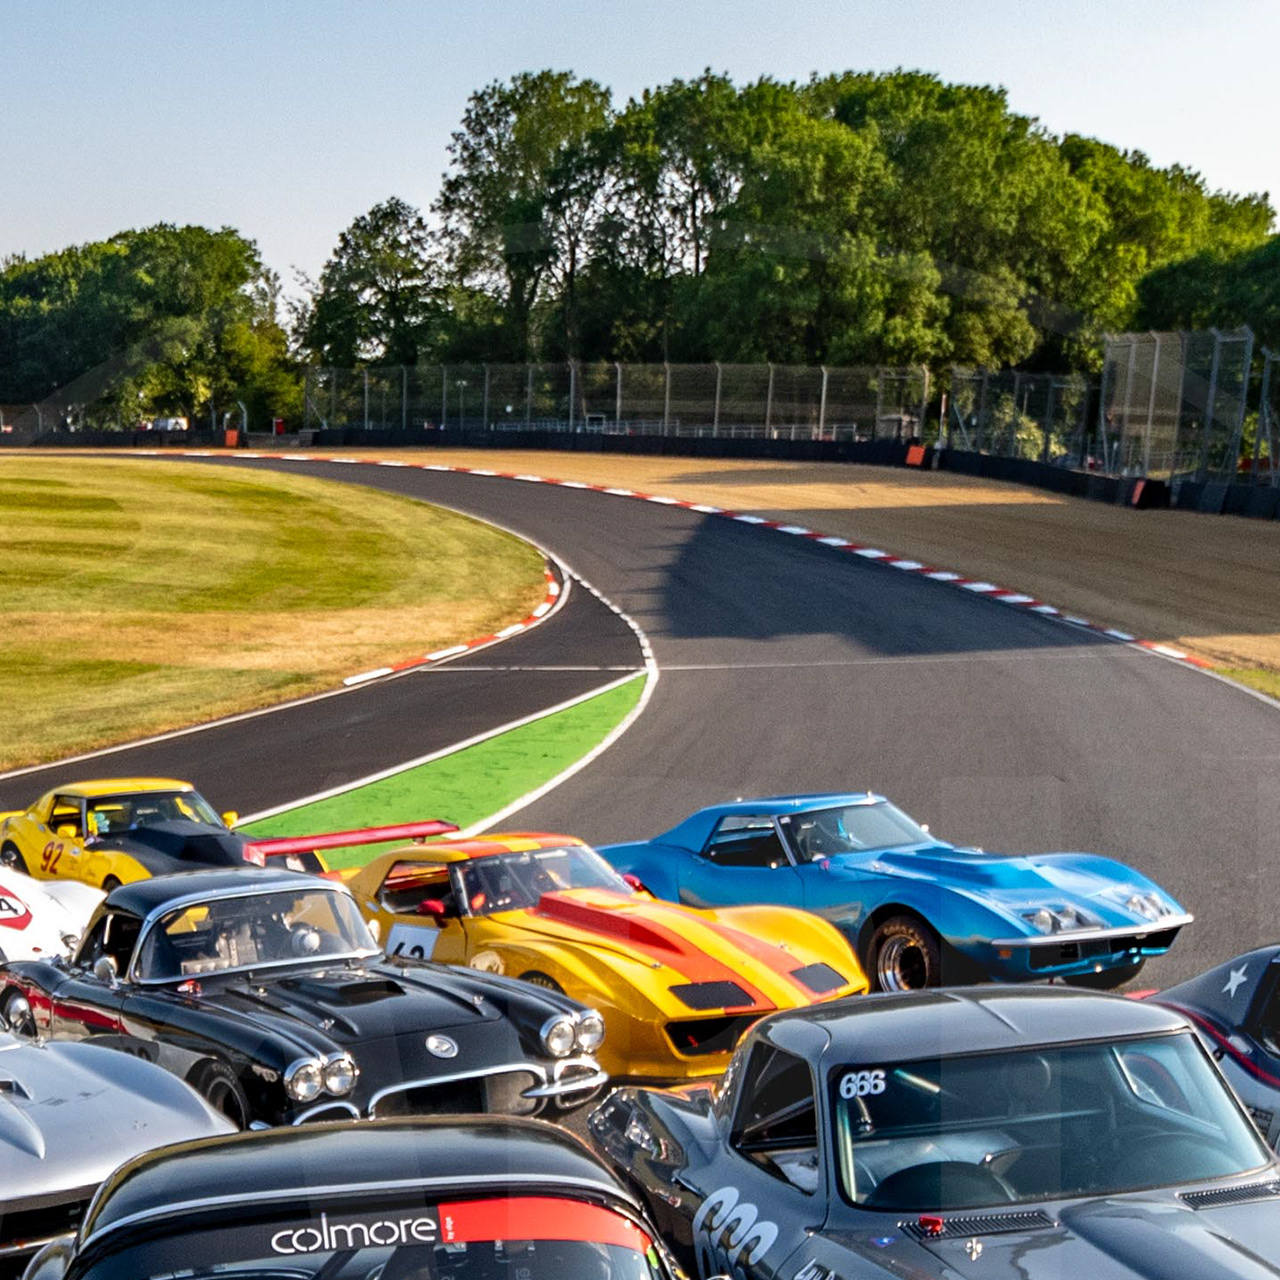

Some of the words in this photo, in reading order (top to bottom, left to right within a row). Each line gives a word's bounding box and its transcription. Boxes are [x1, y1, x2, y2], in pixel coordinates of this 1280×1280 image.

[40, 840, 65, 875] 92
[839, 1068, 888, 1100] 666
[271, 1211, 437, 1255] colmore
